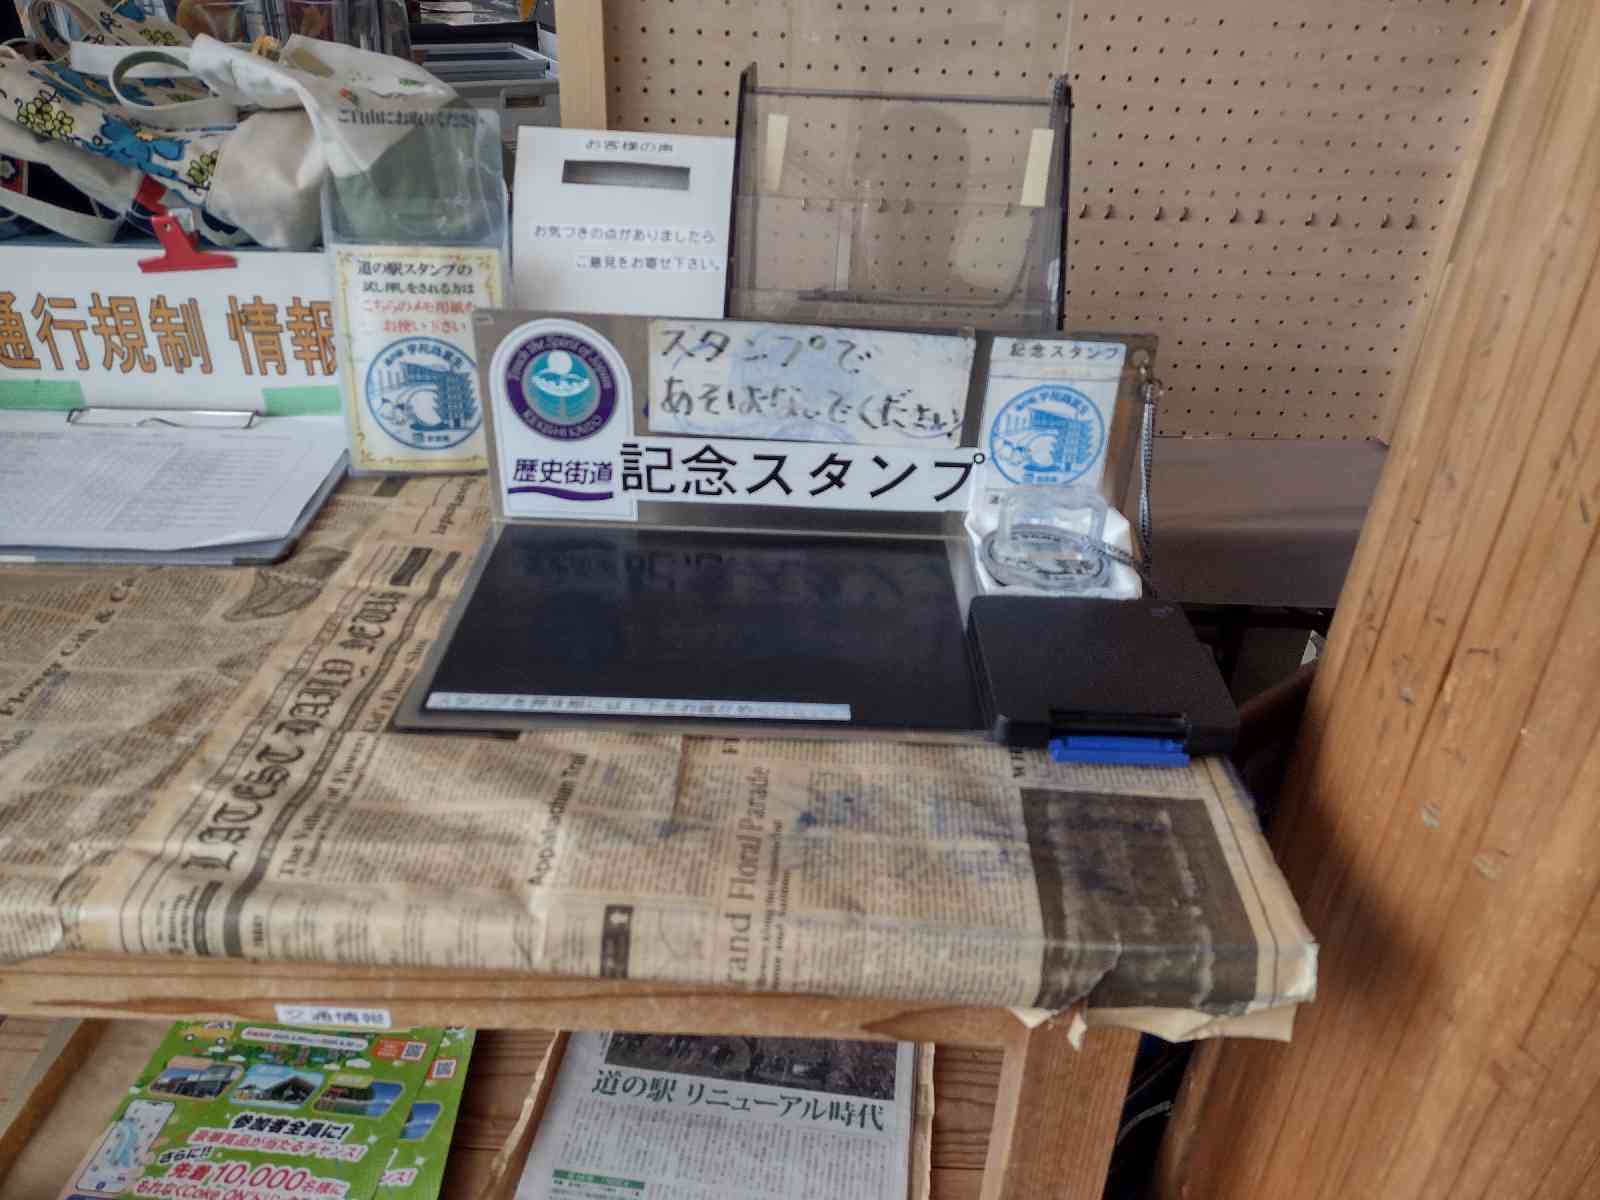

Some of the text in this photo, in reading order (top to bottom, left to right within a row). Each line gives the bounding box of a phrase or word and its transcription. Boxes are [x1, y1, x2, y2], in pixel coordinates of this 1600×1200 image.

[585, 139, 673, 153] お客様の声
[534, 224, 716, 243] お気づきの点がありましたら
[358, 259, 473, 276] 道の駅スタンプの
[576, 256, 721, 271] ご意見をお寄せ下さい。
[362, 281, 475, 295] 試し押しをされる方は
[0, 291, 337, 376] 通行規制 情報
[660, 328, 873, 374] スタンプで
[1010, 342, 1120, 360] 記念スタンプ
[512, 458, 613, 485] 歴史街道
[620, 443, 986, 503] 記念スタンプ
[591, 1070, 884, 1132] 道の駅 リニューアル時代
